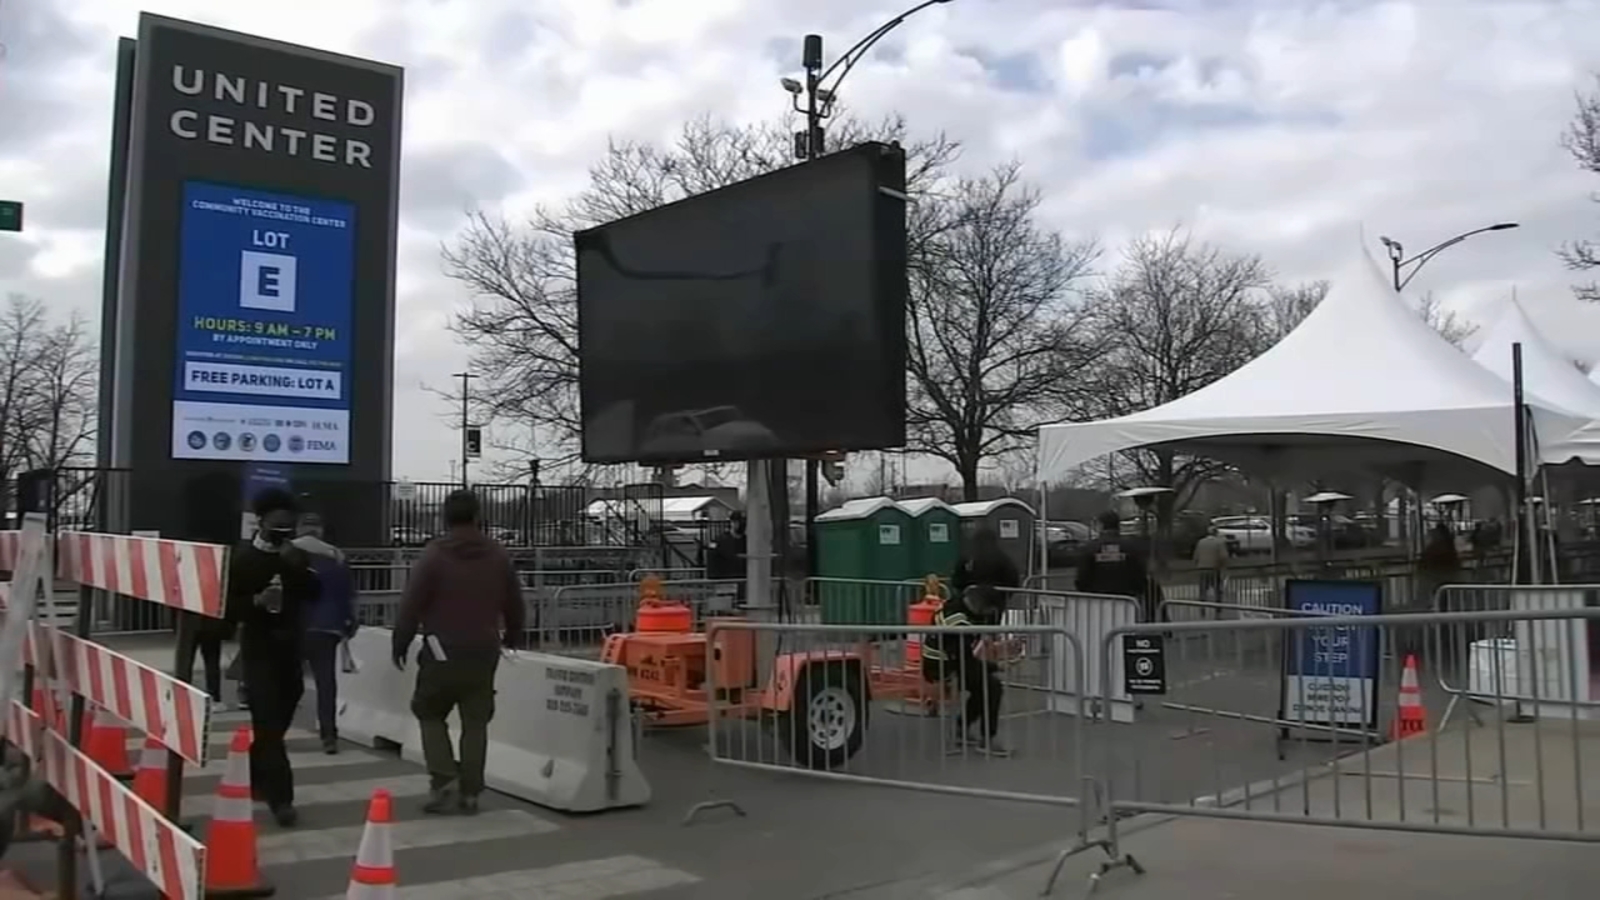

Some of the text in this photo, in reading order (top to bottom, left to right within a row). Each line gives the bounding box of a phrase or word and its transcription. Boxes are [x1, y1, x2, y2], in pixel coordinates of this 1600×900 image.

[173, 65, 375, 126] UNITED
[170, 110, 372, 168] CENTER
[192, 200, 346, 228] COMMUNITY VACCINATION CENTER
[232, 198, 311, 215] WELCOME TO THE
[253, 229, 290, 249] LOT
[257, 265, 281, 298] E
[193, 316, 251, 332] HOURS:
[254, 322, 264, 333] 9
[266, 322, 288, 336] AM
[303, 326, 313, 338] 7
[315, 327, 336, 340] PM
[212, 333, 318, 350] BY APPOINTMENT ONLY
[191, 370, 335, 391] FREE PARKING: LOT A
[307, 439, 337, 450] FEMA
[1300, 602, 1363, 615] CAUTION
[1314, 651, 1348, 663] STEP
